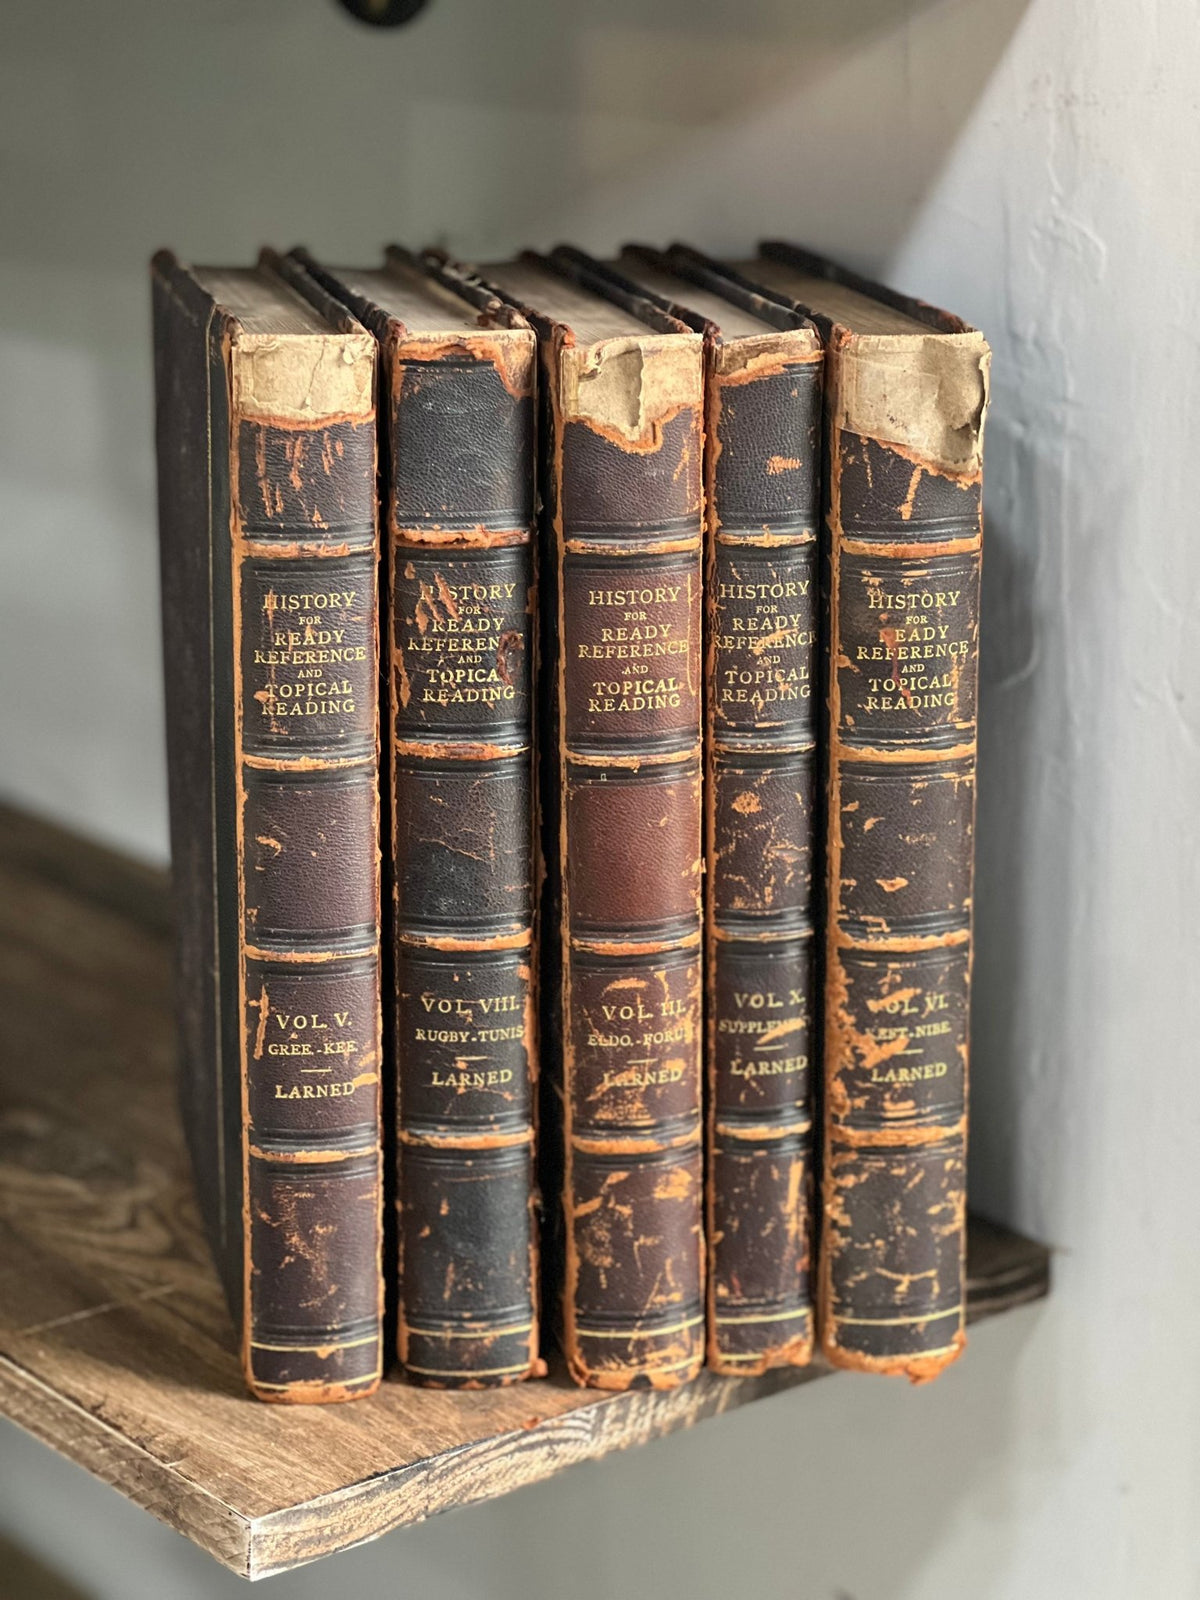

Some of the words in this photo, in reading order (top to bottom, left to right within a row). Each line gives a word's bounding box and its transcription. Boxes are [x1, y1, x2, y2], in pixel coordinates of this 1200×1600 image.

[589, 586, 681, 606] HISTORY
[720, 580, 810, 599] HISTORY
[263, 591, 356, 610] HISTORY
[756, 604, 778, 614] FOR
[868, 591, 960, 609] HISTORY
[458, 605, 482, 615] FOR
[624, 611, 648, 621] FOR
[298, 615, 322, 626] FOR
[432, 617, 504, 632] READY
[732, 614, 802, 631] READY
[906, 615, 928, 625] FOR
[274, 629, 345, 646] READY
[601, 623, 672, 642] READY
[879, 625, 949, 643] EADY
[408, 633, 523, 652] REFEREN
[578, 640, 690, 659] REFERENCE
[857, 640, 969, 660] REFERENCE
[254, 646, 367, 664] REFERENCE
[457, 655, 482, 664] AND
[757, 655, 781, 665] AND
[297, 668, 322, 678] AND
[623, 665, 649, 675] AND
[725, 666, 809, 684] TOPICAL
[901, 663, 925, 673] AND
[265, 680, 353, 698] TOPICAL
[592, 677, 679, 696] TOPICAL
[868, 674, 952, 692] TOPICAL
[423, 685, 516, 703] READING
[722, 684, 811, 702] READING
[866, 692, 955, 710] READING
[262, 698, 356, 716] READING
[588, 693, 681, 712] READING
[734, 992, 784, 1009] VOL.
[276, 1013, 328, 1030] VOL.
[333, 1011, 353, 1027] V.
[602, 1004, 654, 1020] VOL.
[730, 1055, 808, 1076] LARNED
[871, 1062, 947, 1082] LARNED
[431, 1069, 513, 1086] LARNED
[275, 1082, 355, 1099] LARNED
